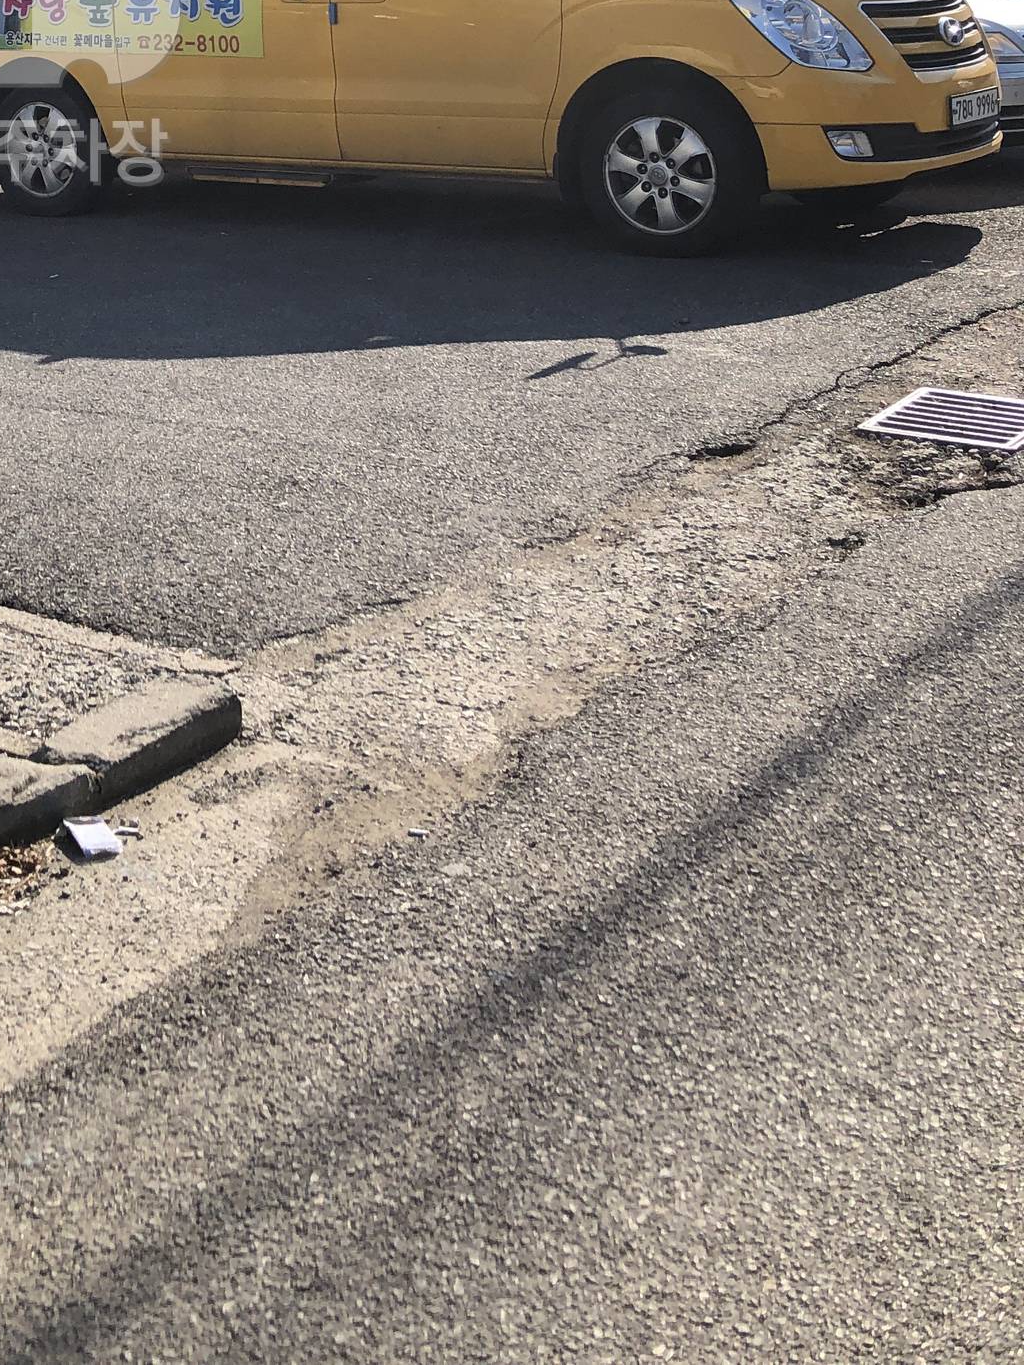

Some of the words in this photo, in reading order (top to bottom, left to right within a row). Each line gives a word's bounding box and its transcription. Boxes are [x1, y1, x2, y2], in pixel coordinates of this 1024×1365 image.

[5, 30, 42, 47] 용산지구
[153, 34, 240, 54] 232-8100
[976, 93, 996, 116] 9996
